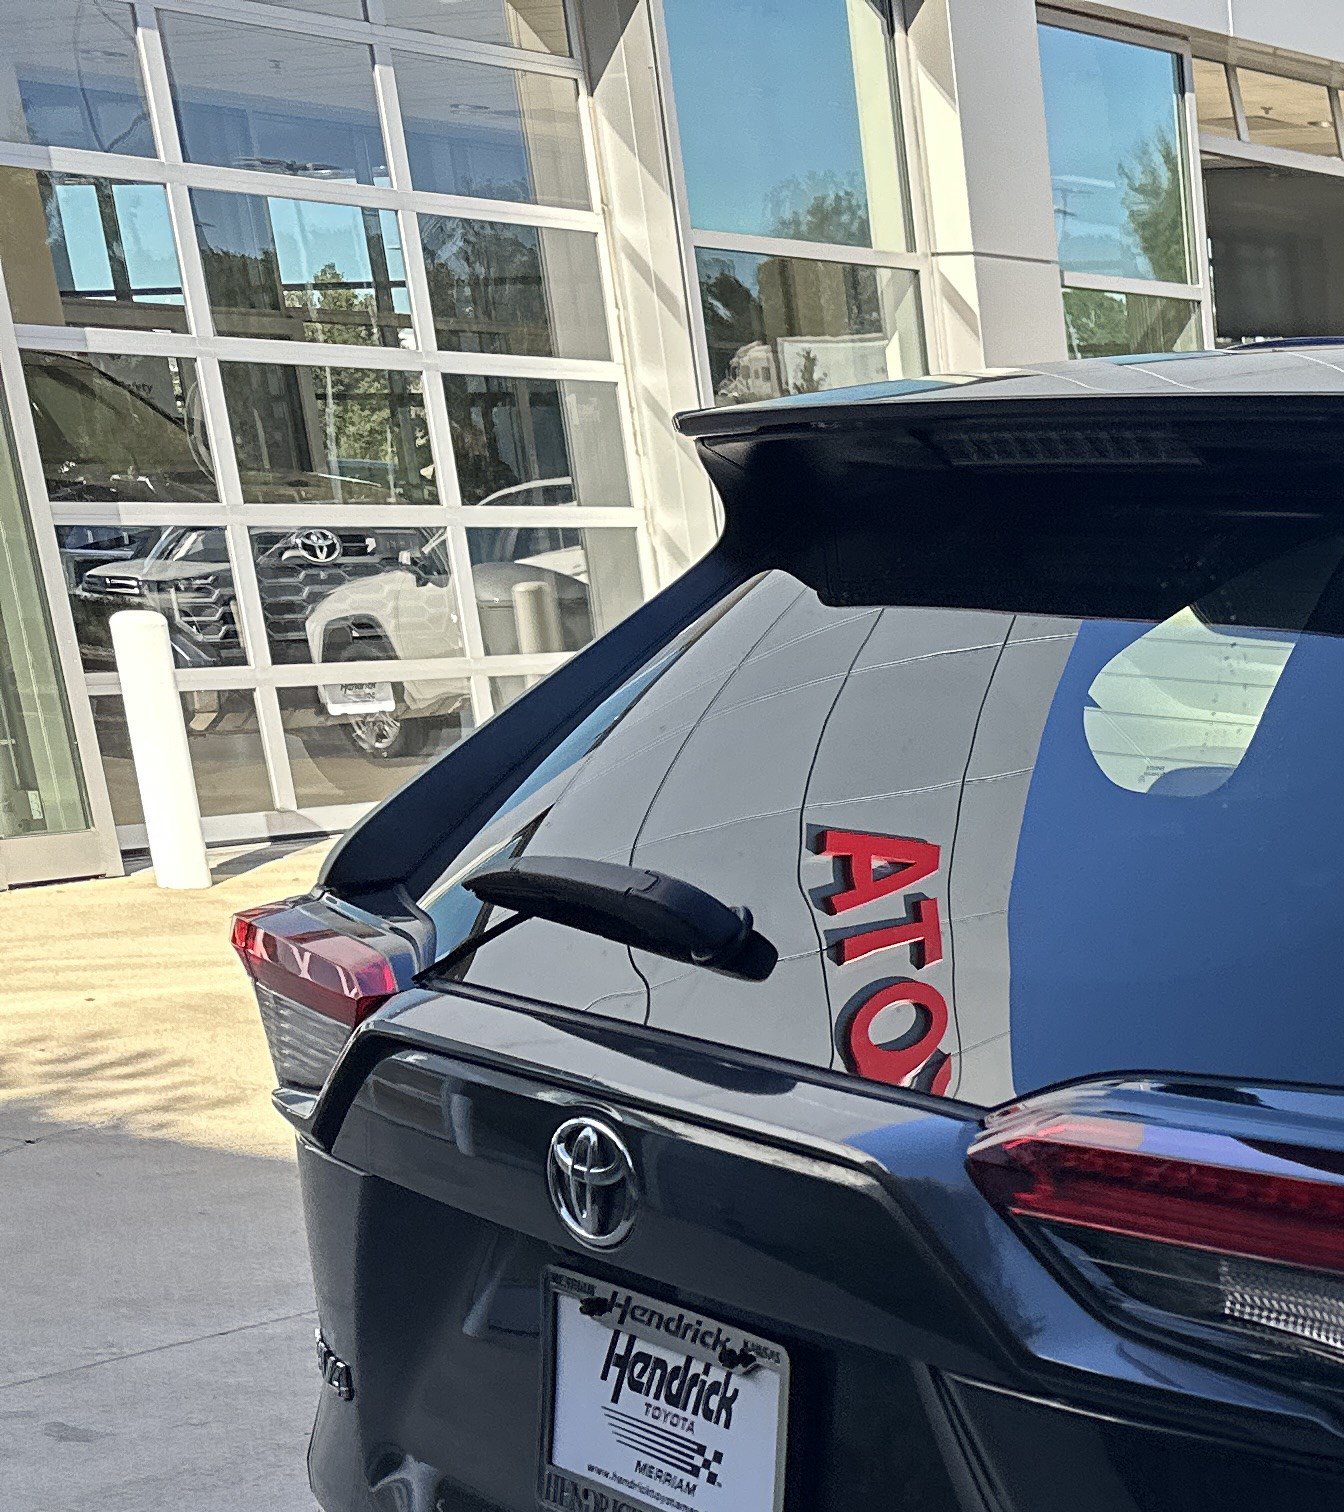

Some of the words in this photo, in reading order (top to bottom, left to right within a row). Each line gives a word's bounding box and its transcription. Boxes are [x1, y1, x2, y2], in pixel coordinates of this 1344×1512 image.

[606, 1290, 732, 1353] Hendrick
[600, 1329, 740, 1430] Hendrick
[644, 1402, 696, 1435] TOYOTA
[634, 1459, 699, 1497] MERRIAM
